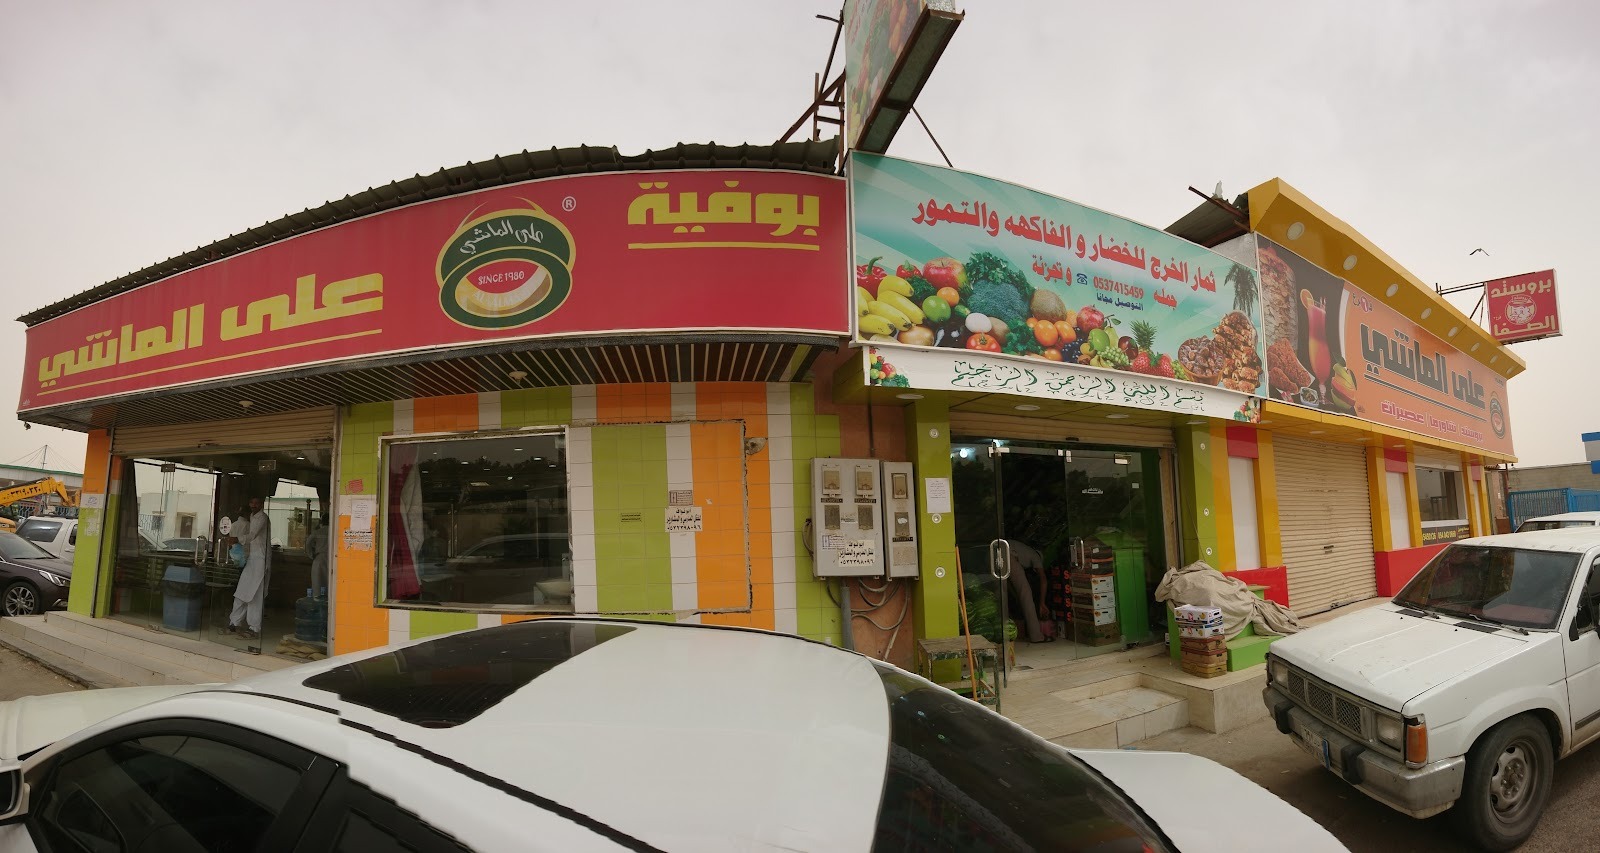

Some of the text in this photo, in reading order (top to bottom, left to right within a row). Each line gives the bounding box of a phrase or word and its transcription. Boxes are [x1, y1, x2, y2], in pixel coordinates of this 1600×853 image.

[628, 181, 819, 236] بوفية
[912, 198, 999, 237] والتمور
[460, 219, 544, 254] على الماشي
[1005, 215, 1072, 250] الفاكهه
[1088, 234, 1146, 270] للخضار
[477, 270, 525, 285] SINCE 1980
[1151, 256, 1189, 283] الخرج
[1191, 266, 1216, 293] ثمار
[1093, 275, 1144, 299] 0537415459
[1491, 278, 1552, 298] بروستد
[1115, 297, 1144, 311] التوصيل
[39, 272, 384, 388] على الماشي
[1494, 314, 1556, 336] الصفا
[1360, 322, 1486, 410] على الماشي
[951, 360, 1204, 411] بسم الله الرحمن الرحيم
[1380, 399, 1425, 424] عصيرات
